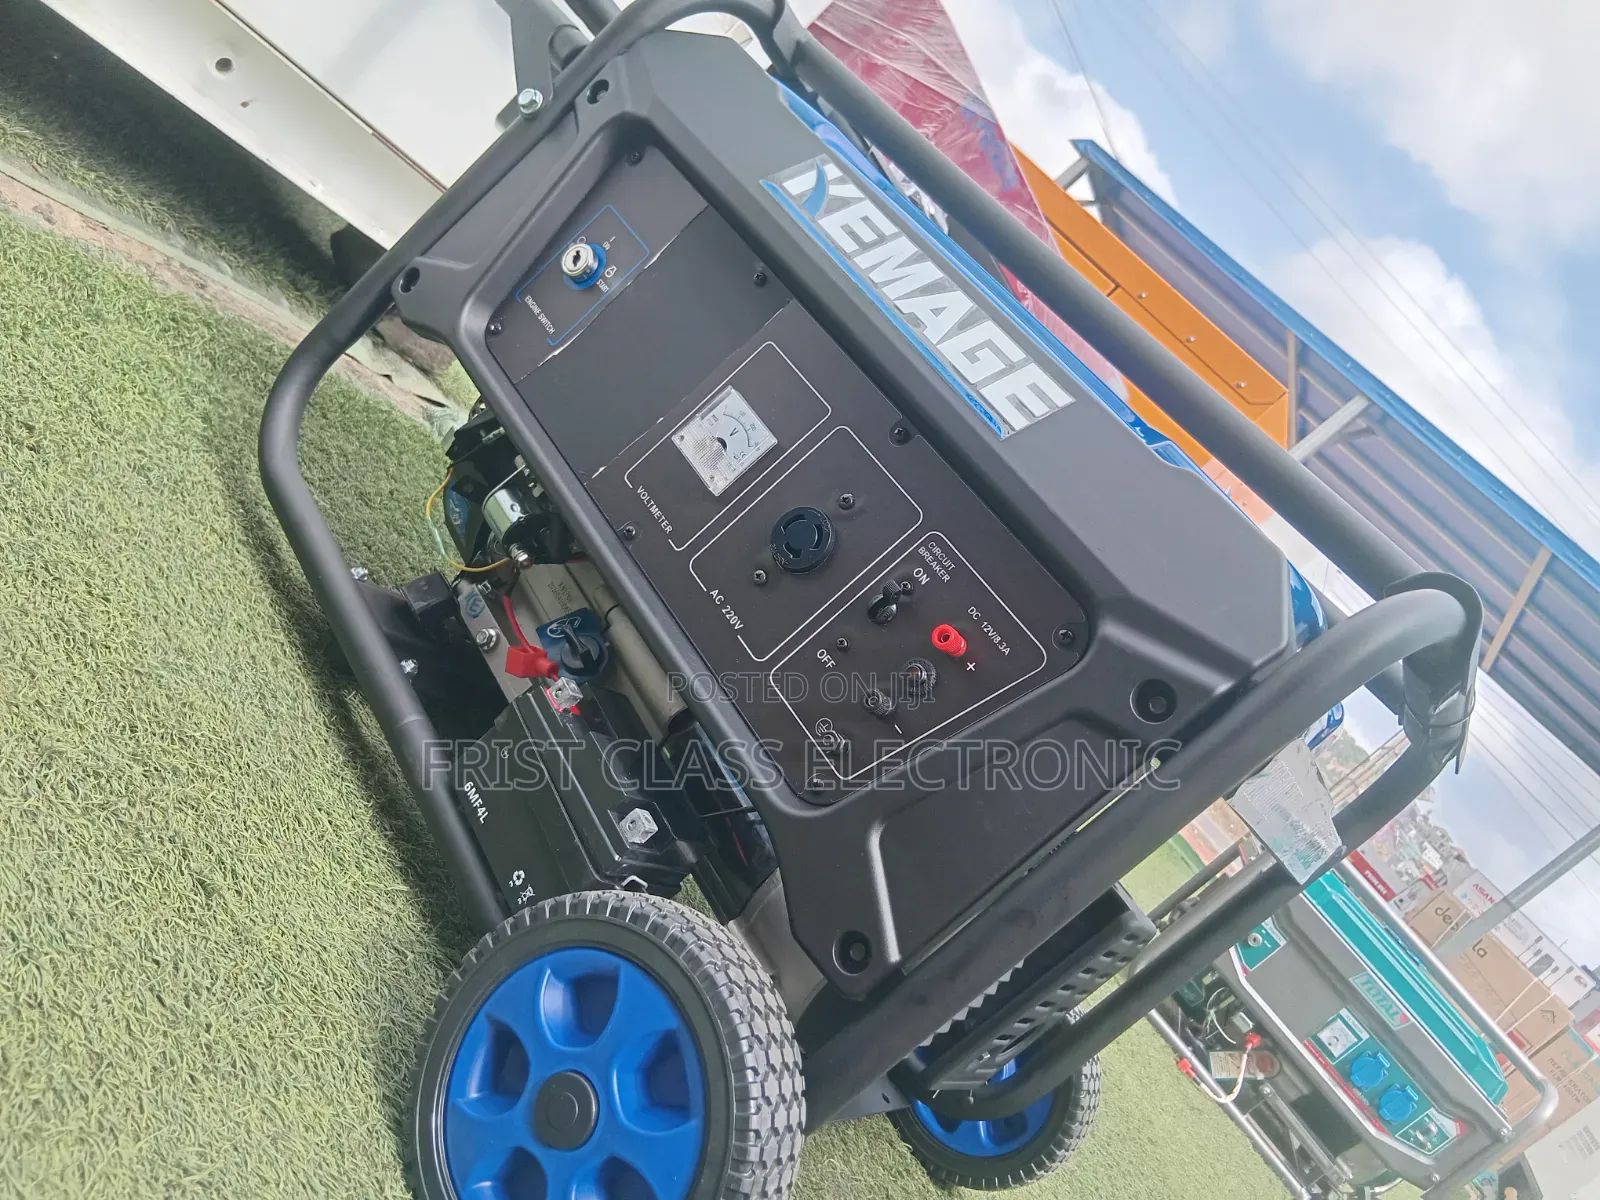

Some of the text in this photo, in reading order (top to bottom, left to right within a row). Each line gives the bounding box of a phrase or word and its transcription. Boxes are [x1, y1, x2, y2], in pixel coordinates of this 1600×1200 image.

[596, 278, 609, 293] START
[782, 159, 1076, 431] KEMAGE
[524, 295, 556, 335] ENGINE SWITCH
[729, 427, 739, 437] V
[636, 485, 673, 535] VOLTMETER
[918, 546, 951, 583] BREAKER
[928, 541, 956, 571] CIRCUIT
[913, 567, 931, 585] ON
[709, 589, 744, 630] AC 220V
[967, 606, 1011, 656] DC 12V/8.3A
[816, 648, 837, 670] OFF
[464, 781, 489, 824] 6MF4L
